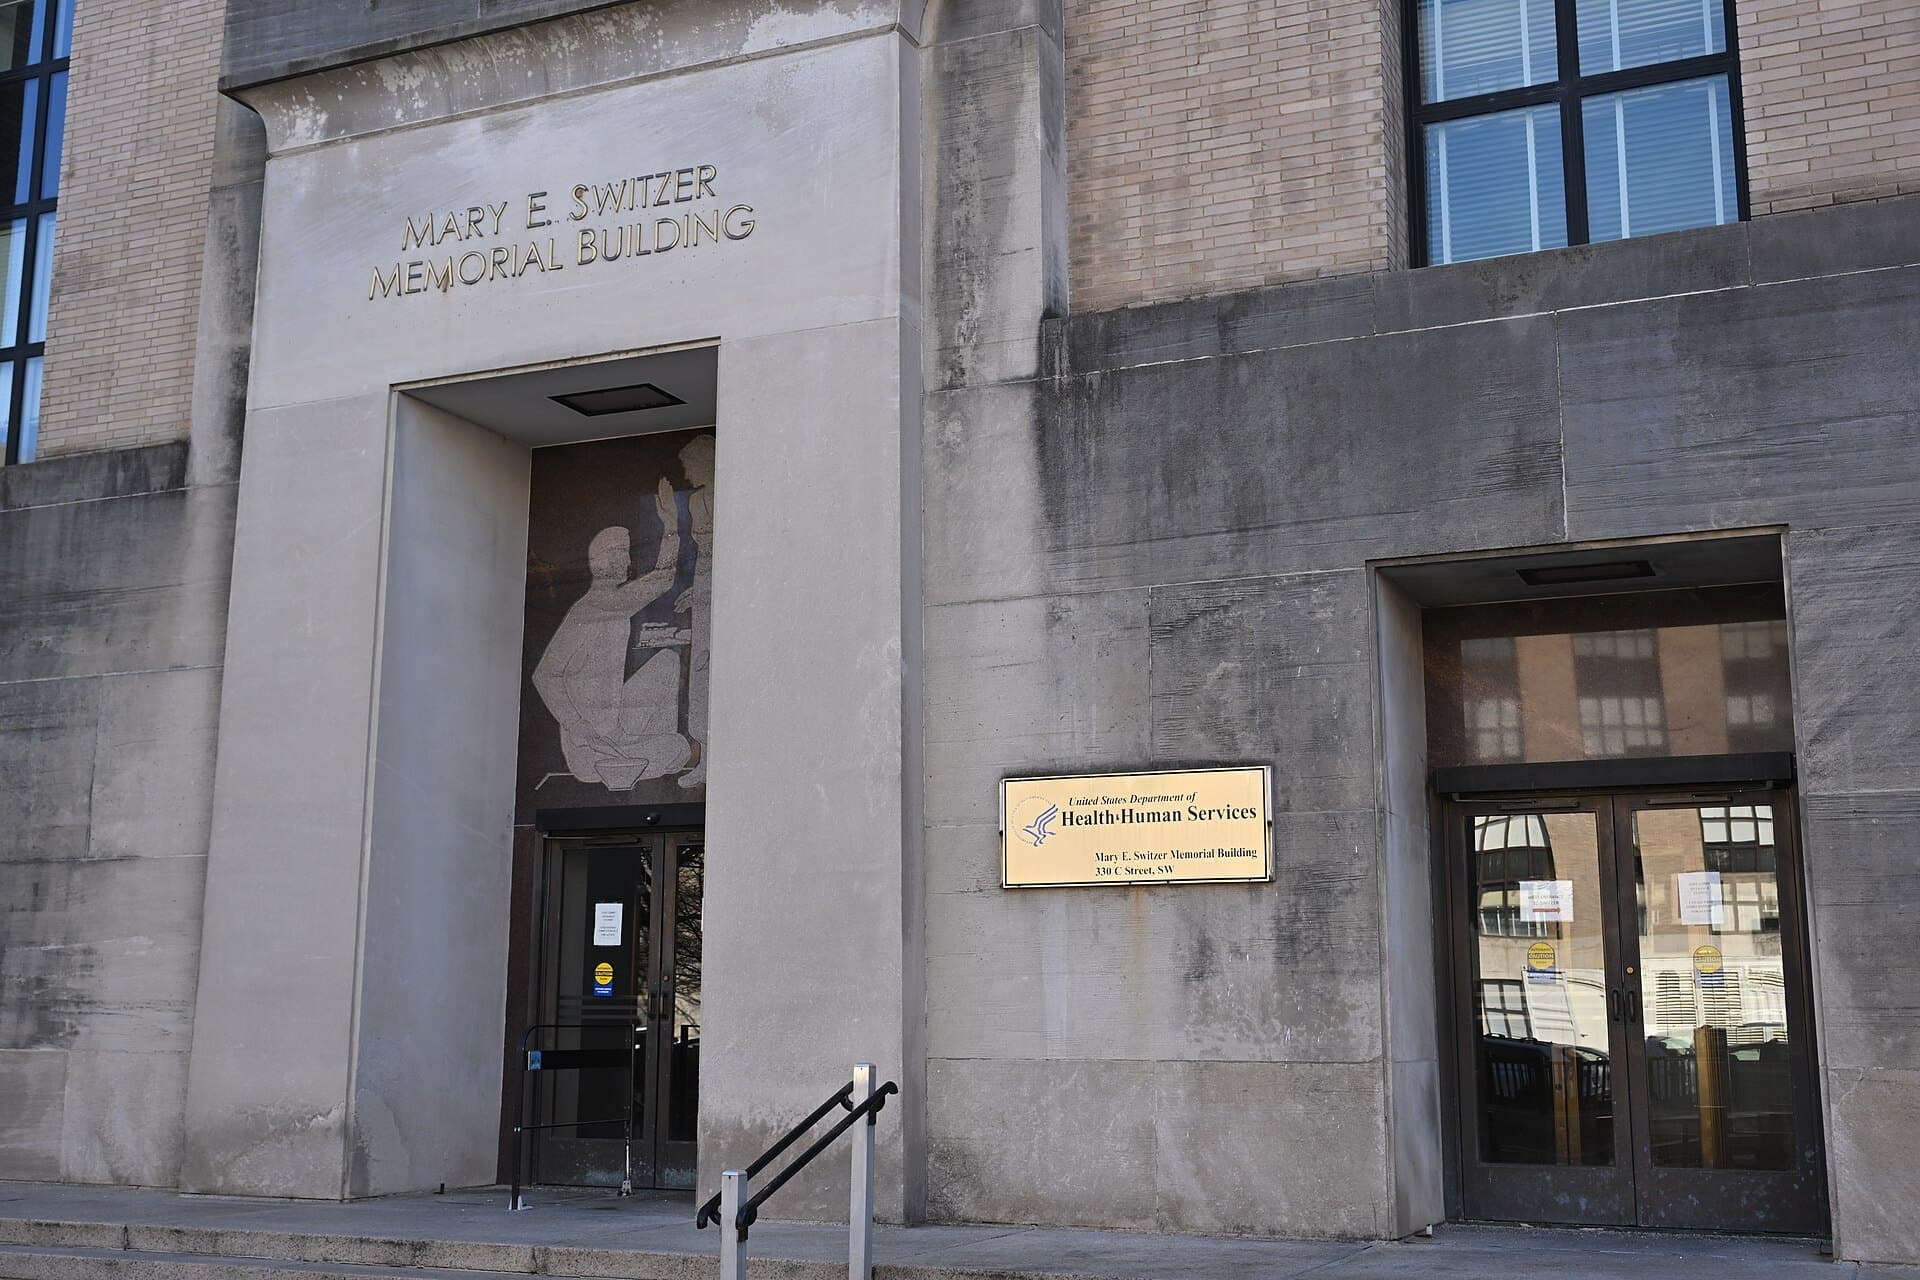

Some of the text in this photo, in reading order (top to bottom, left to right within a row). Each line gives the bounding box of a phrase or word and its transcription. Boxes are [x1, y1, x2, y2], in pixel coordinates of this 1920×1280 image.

[401, 164, 718, 251] MARY E. SWITZER
[368, 204, 756, 301] MEMORIAL BUILDING
[1069, 791, 1198, 807] United States Department of
[1121, 808, 1182, 824] Human
[1187, 803, 1257, 821] Services
[1095, 847, 1258, 864] Mary E. Switzer Memorial Building
[1095, 864, 1174, 877] 330 C Street, SW
